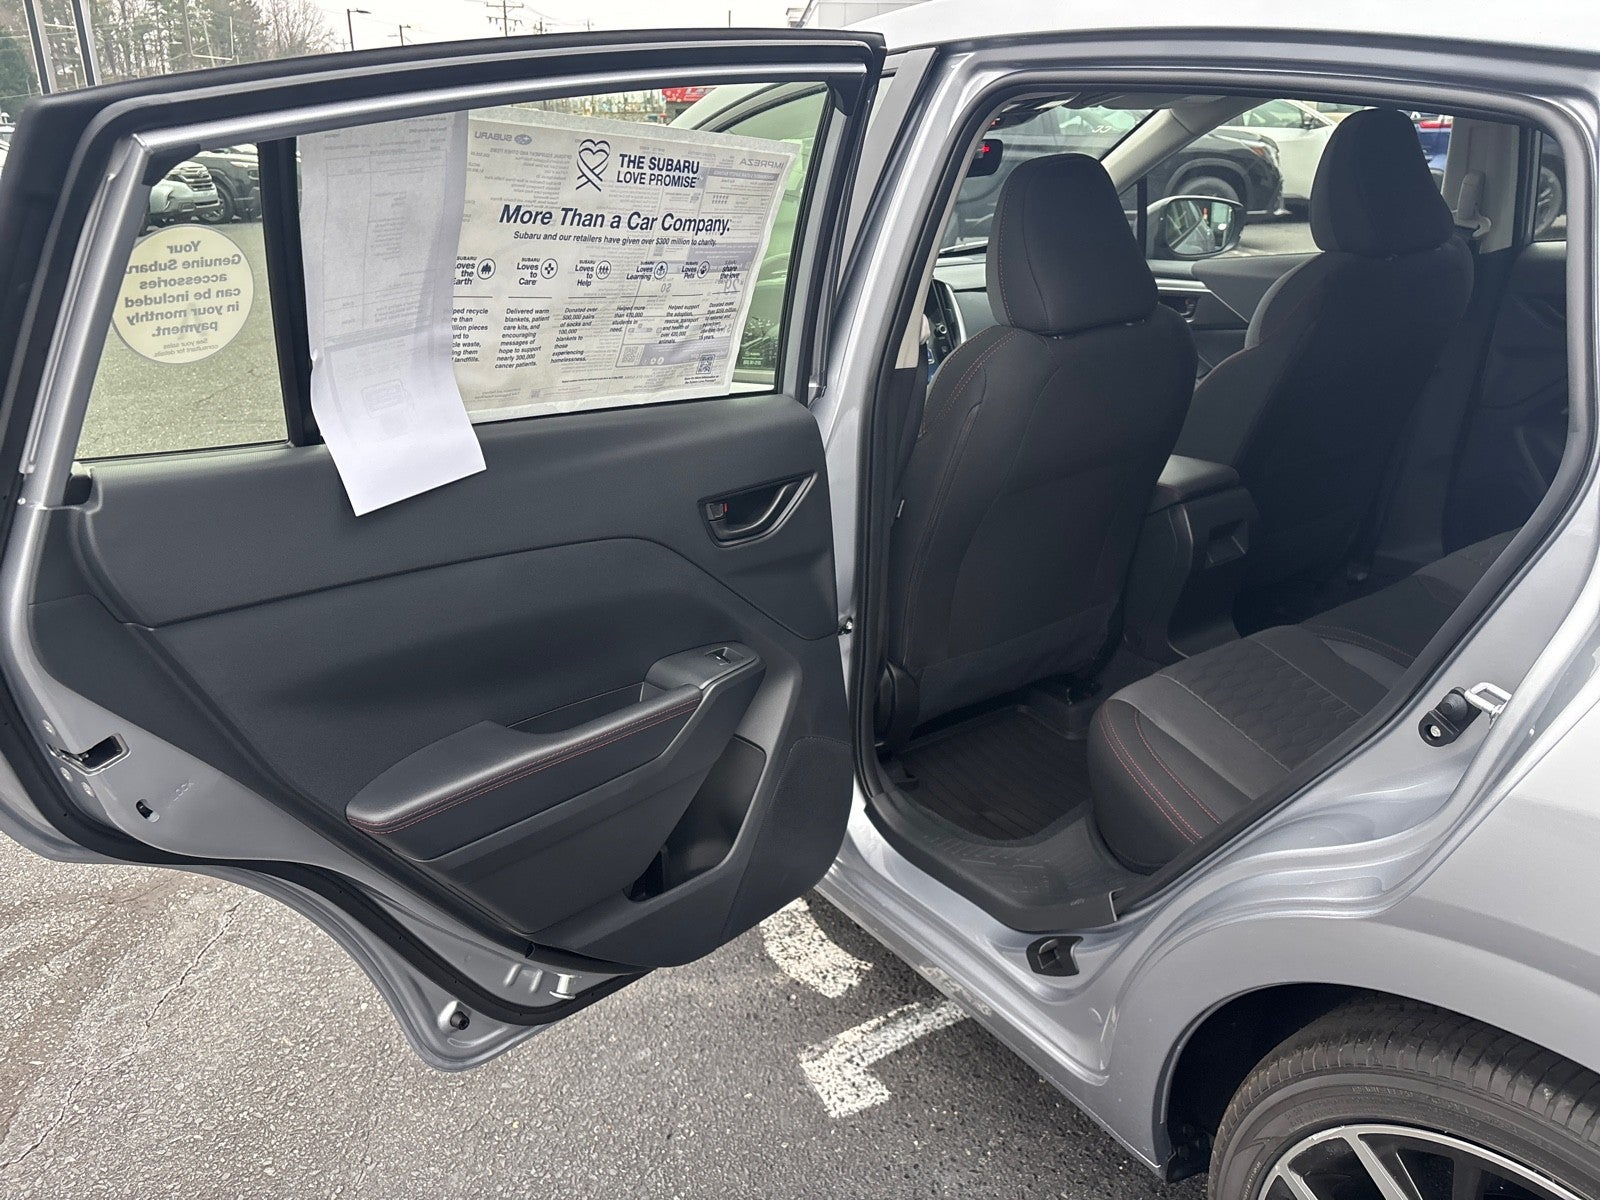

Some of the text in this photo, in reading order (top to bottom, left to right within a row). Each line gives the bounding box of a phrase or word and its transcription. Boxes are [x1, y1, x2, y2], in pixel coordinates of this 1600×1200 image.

[619, 153, 645, 170] THE
[648, 156, 700, 175] SUBARU
[616, 170, 696, 188] LOVE PROMISE
[499, 204, 553, 225] More
[560, 208, 605, 228] Than
[610, 215, 622, 230] a
[627, 212, 658, 231] Car
[661, 213, 730, 236] Company.
[513, 231, 541, 240] Subaru
[543, 232, 557, 240] and
[573, 234, 602, 242] retailers
[604, 234, 620, 243] have
[622, 236, 640, 246] given
[656, 238, 670, 246] $300
[670, 238, 690, 246] million
[691, 238, 697, 246] to
[698, 238, 717, 247] charity.
[516, 263, 539, 271] Loves
[574, 264, 594, 272] Loves
[626, 273, 652, 281] Learning
[684, 272, 695, 280] Pets
[518, 278, 537, 286] Care
[577, 279, 592, 288] Help
[453, 308, 488, 316] ped recycle
[532, 316, 550, 324] patient
[502, 332, 536, 340] encouraging
[521, 346, 542, 354] support
